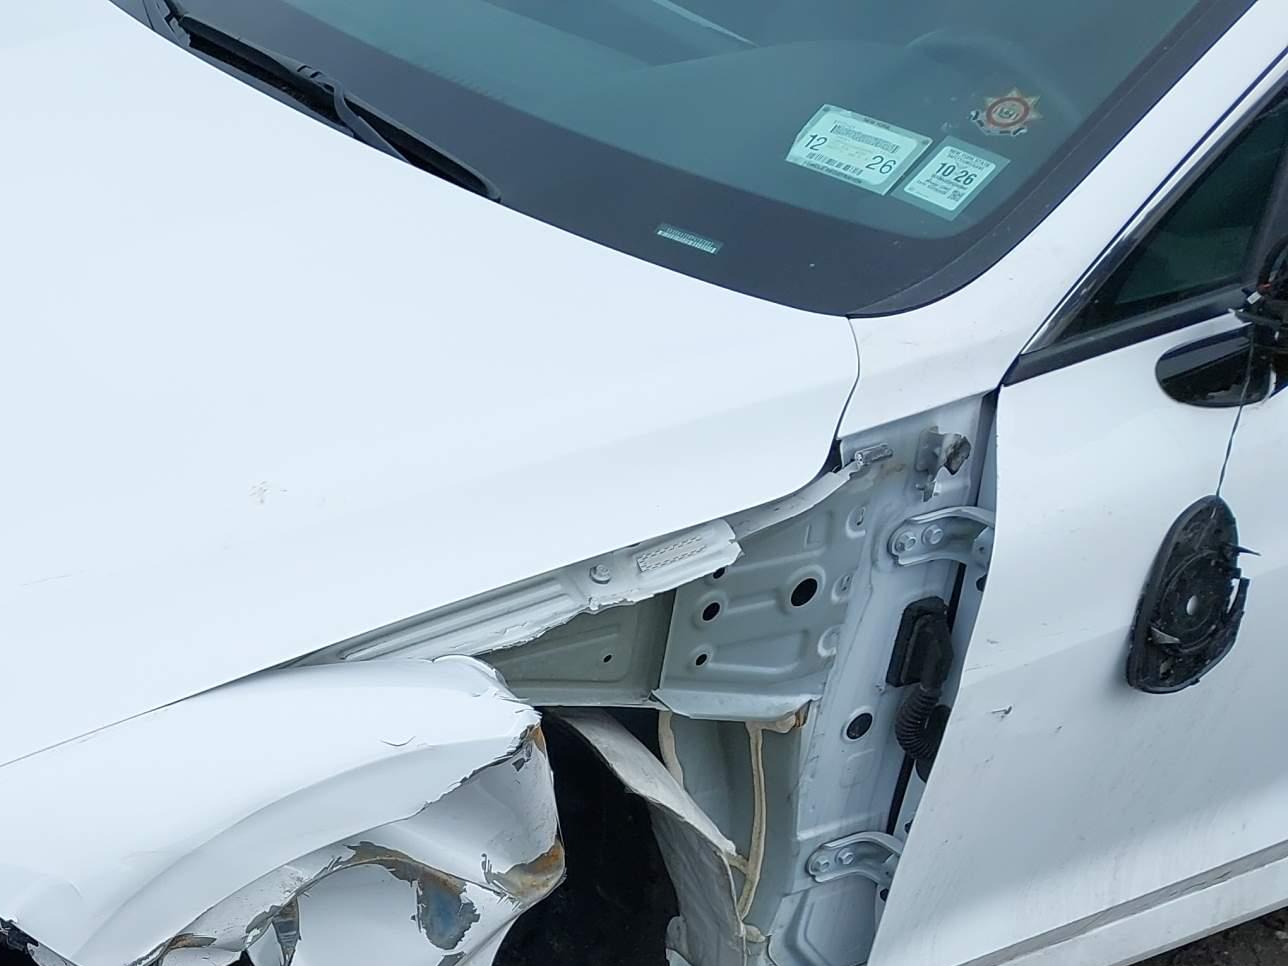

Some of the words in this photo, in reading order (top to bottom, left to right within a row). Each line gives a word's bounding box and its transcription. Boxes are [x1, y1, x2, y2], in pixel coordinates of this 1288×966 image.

[805, 133, 828, 151] 12
[865, 155, 897, 175] 26
[936, 163, 956, 177] 10
[954, 170, 977, 186] 26
